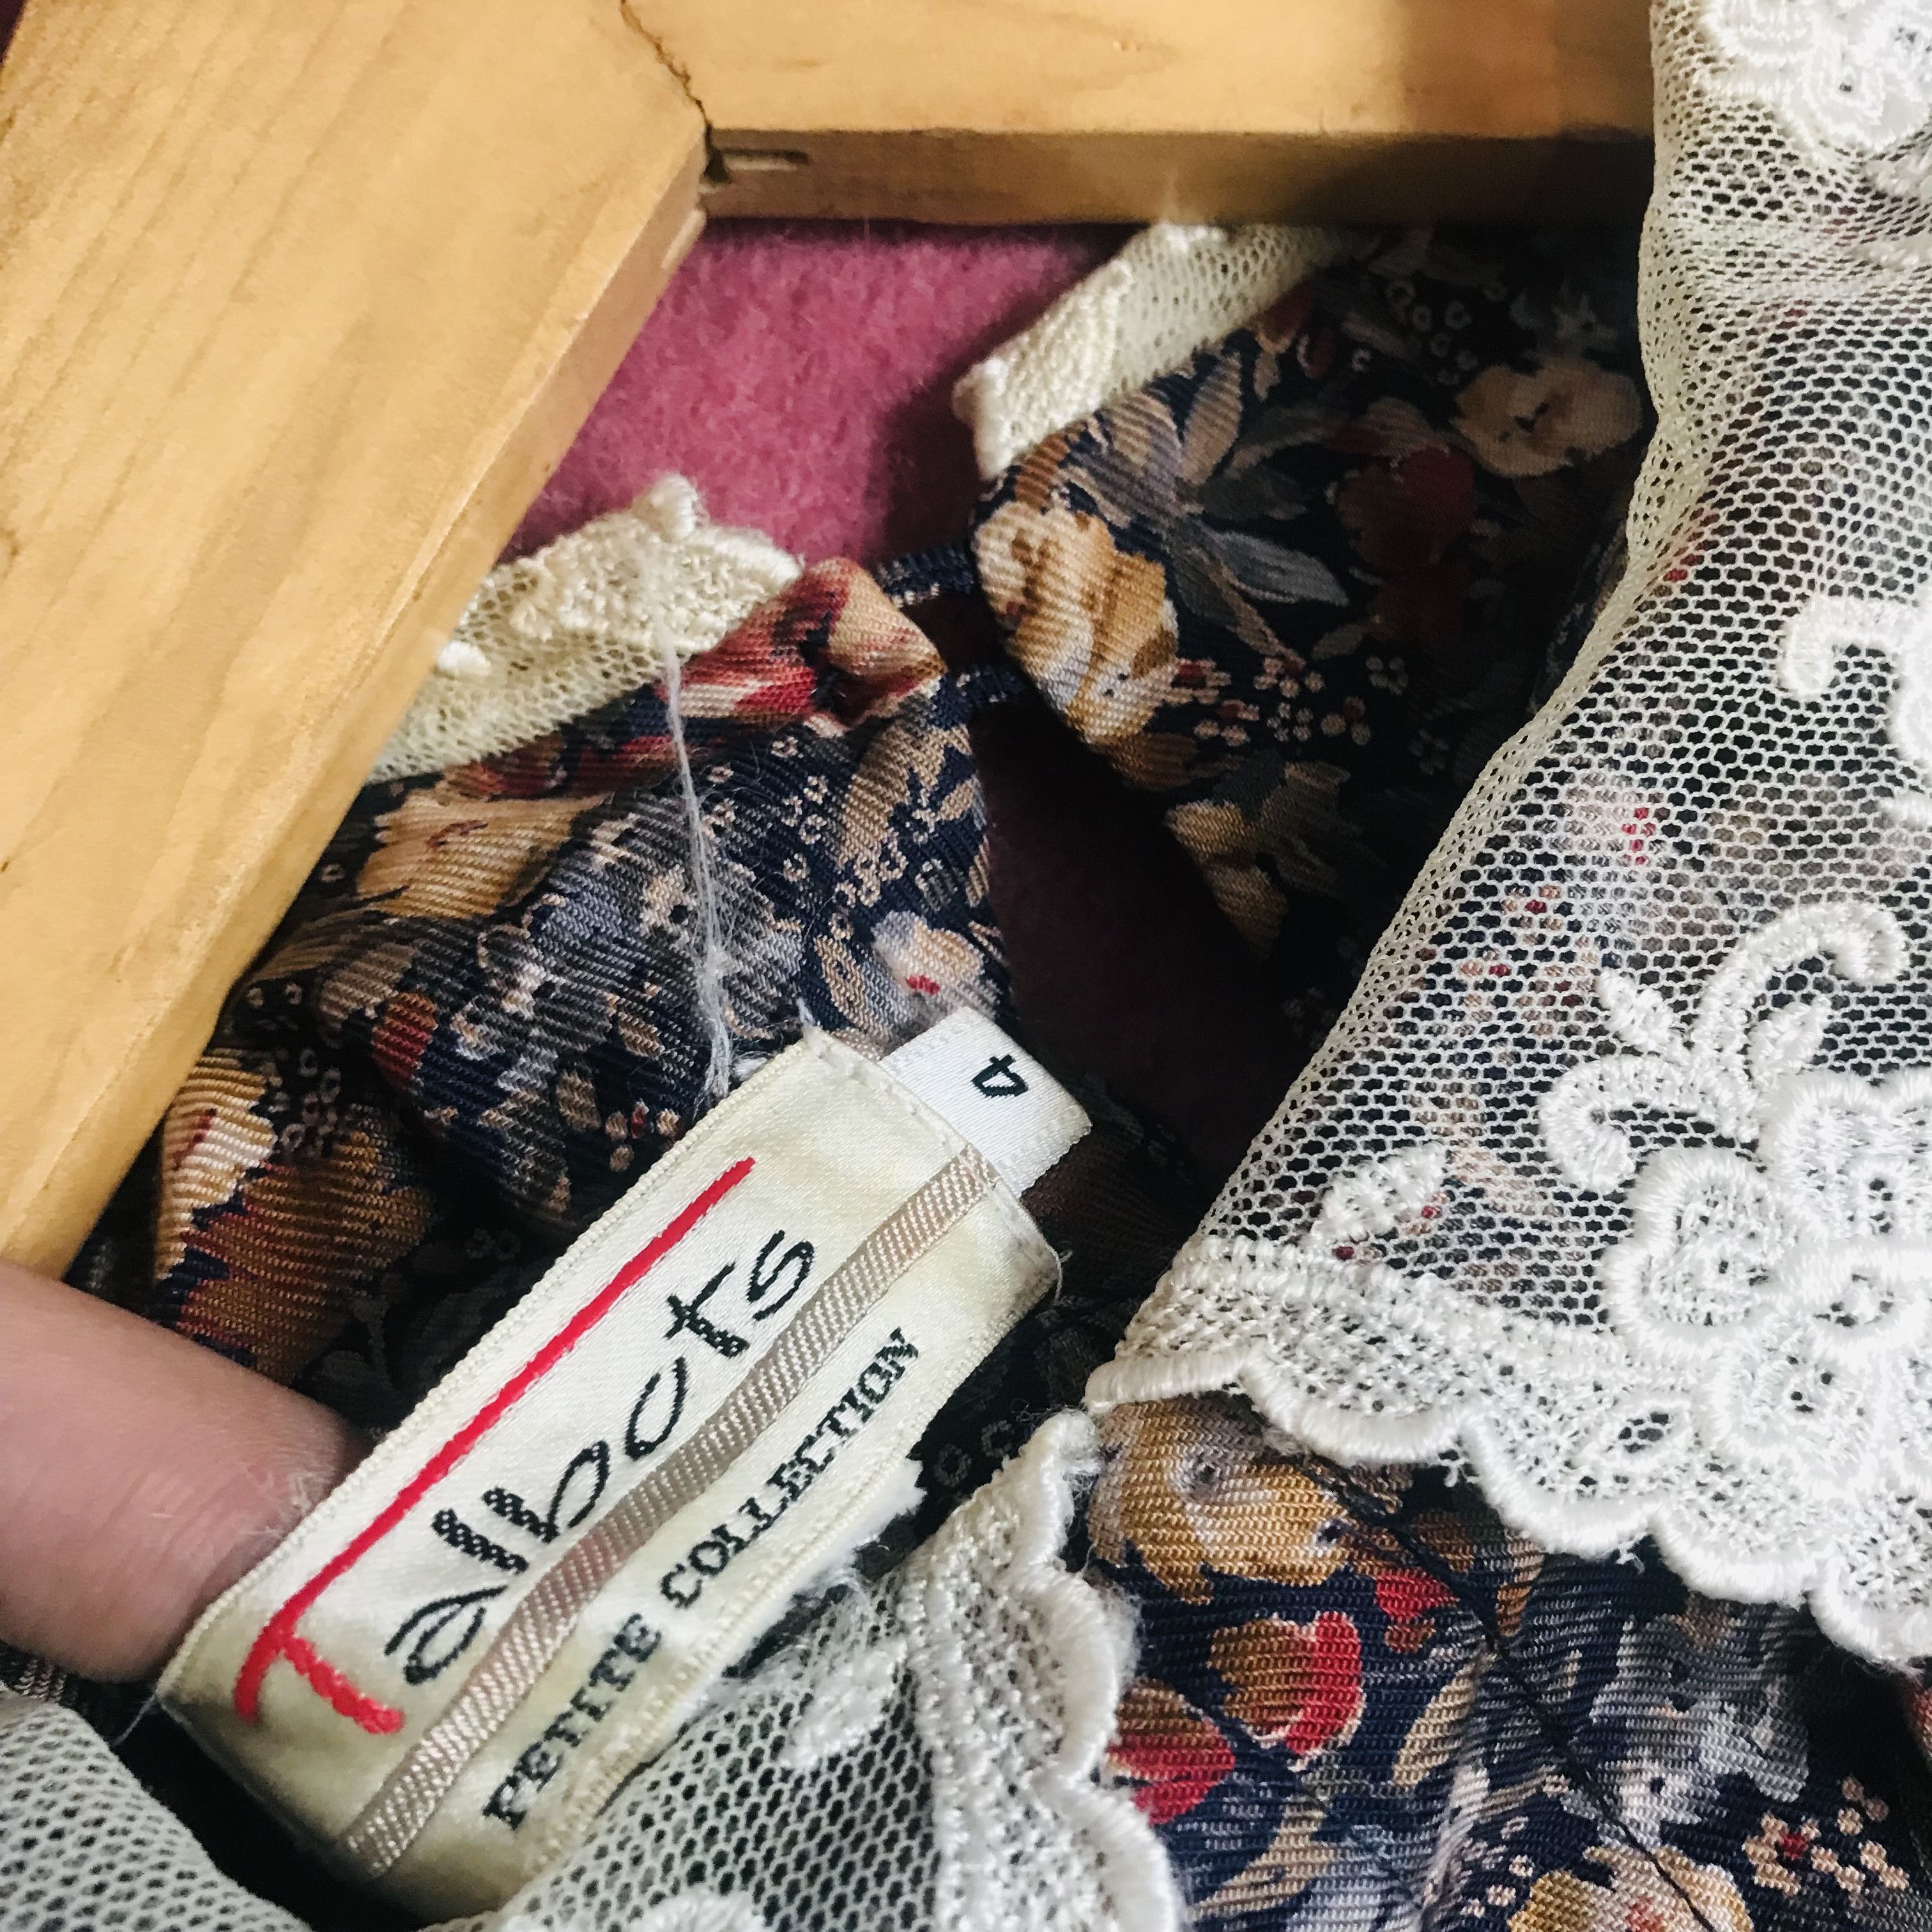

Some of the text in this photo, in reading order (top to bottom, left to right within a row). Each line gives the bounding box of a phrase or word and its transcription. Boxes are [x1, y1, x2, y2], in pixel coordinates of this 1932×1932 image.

[970, 1054, 1028, 1098] 4
[235, 1157, 815, 1734] Talbots
[482, 1327, 919, 1830] PETITE COLLECTION
